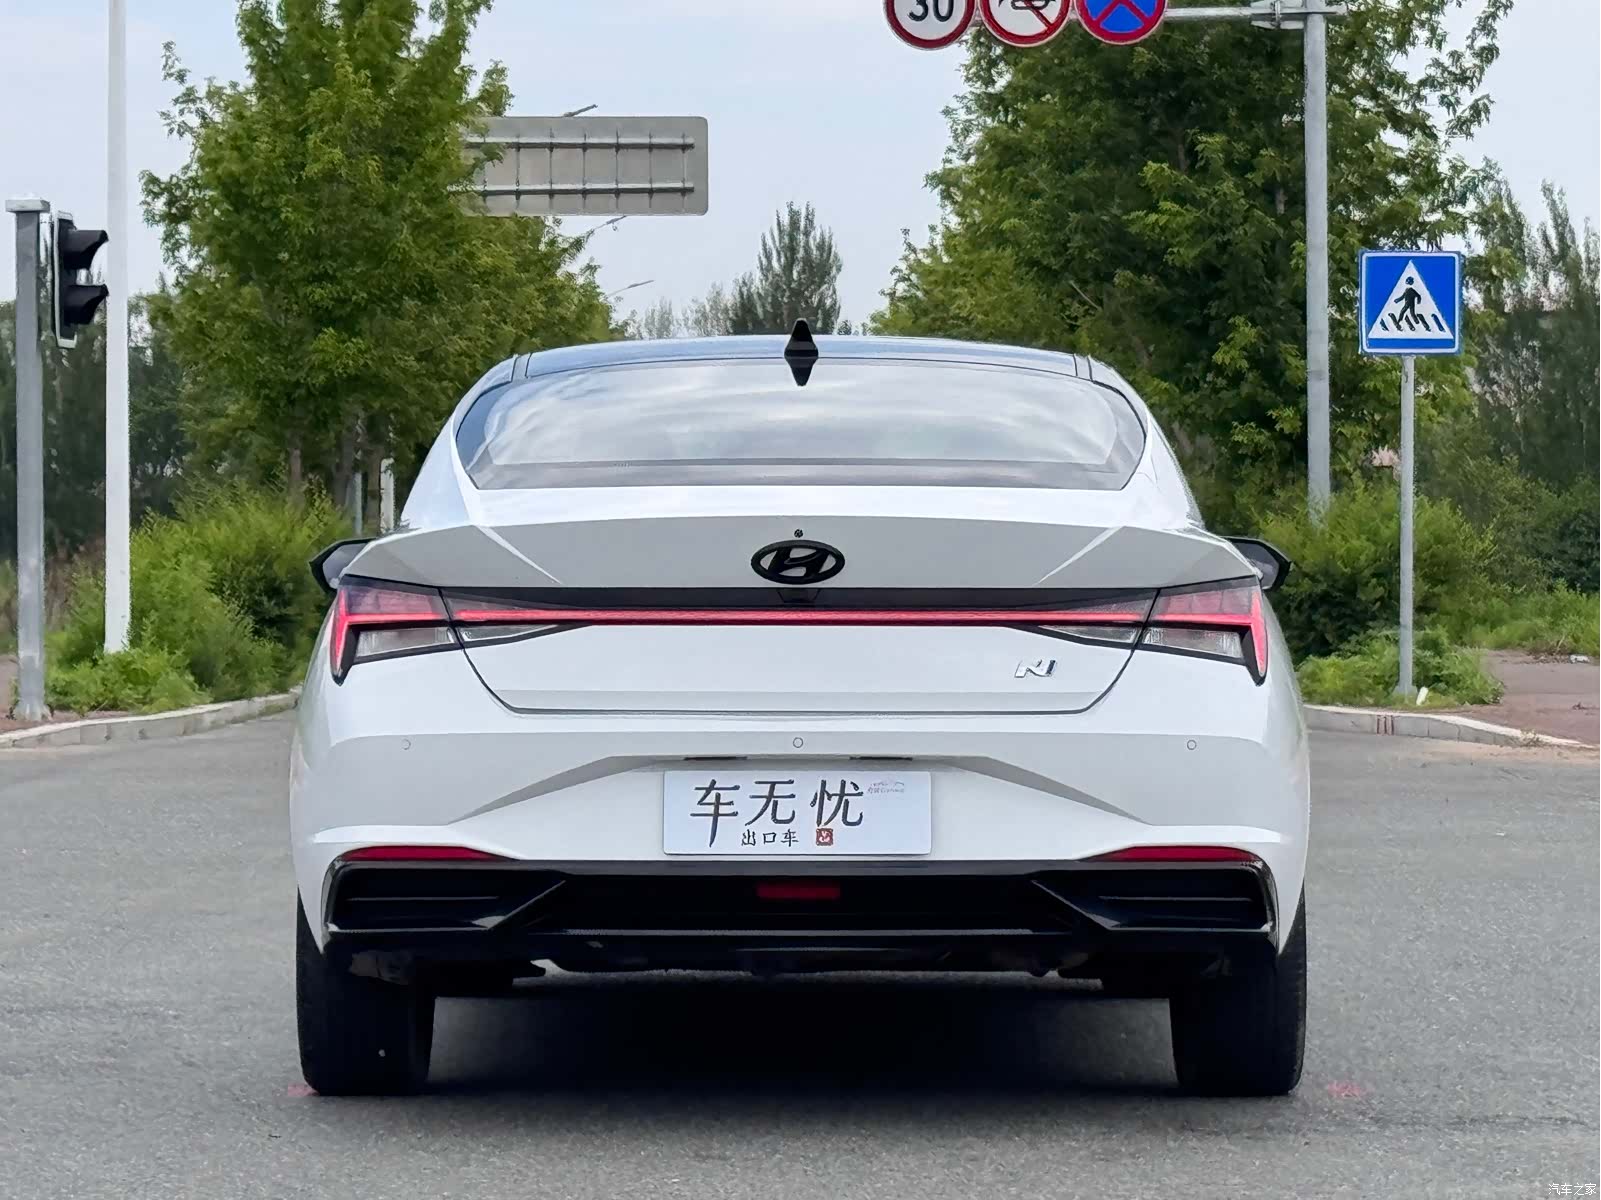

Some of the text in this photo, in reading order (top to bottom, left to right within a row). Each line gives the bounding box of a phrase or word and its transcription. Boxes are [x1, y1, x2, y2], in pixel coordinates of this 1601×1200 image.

[907, 0, 954, 22] 30
[690, 779, 863, 847] 车无忧
[741, 829, 799, 847] 出口车
